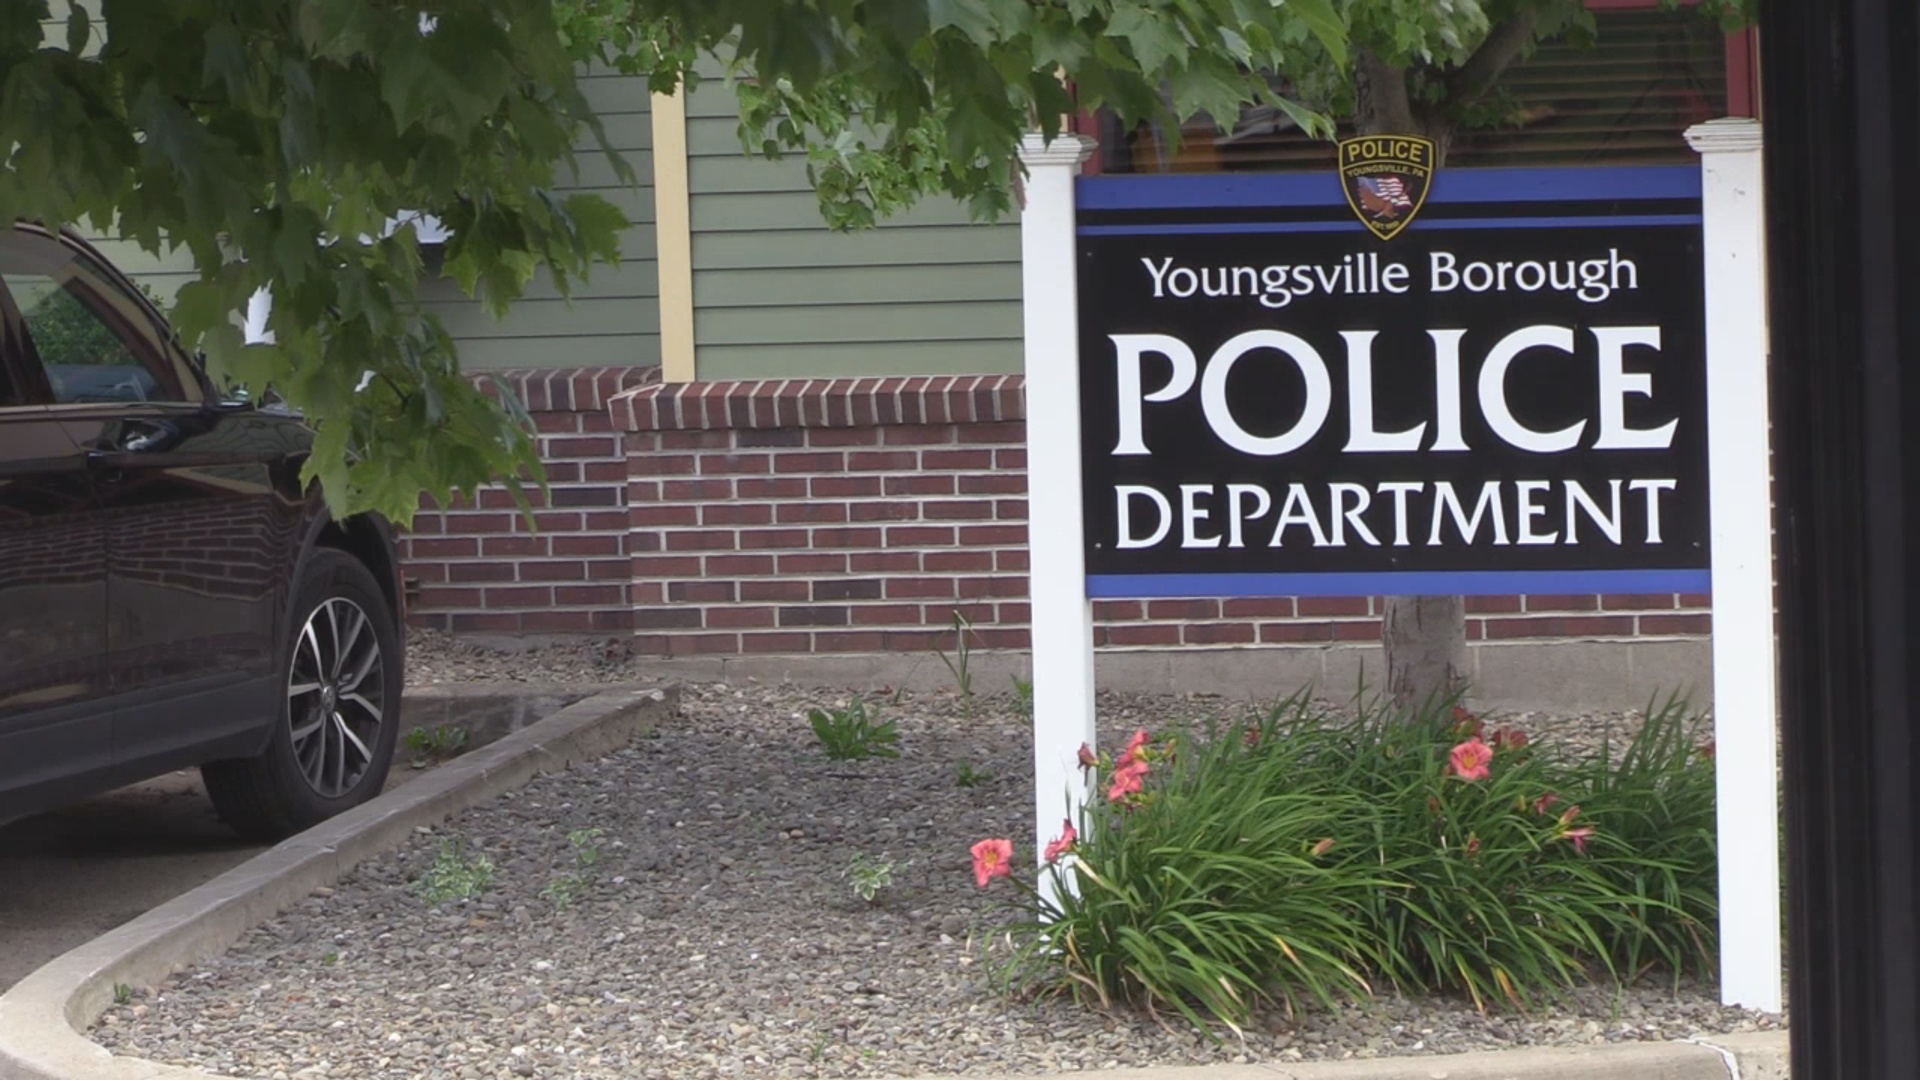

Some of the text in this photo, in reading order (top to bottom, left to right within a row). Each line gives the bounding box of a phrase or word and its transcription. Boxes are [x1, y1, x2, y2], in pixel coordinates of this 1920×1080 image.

[1348, 141, 1423, 161] POLICE
[1412, 169, 1424, 177] PA
[1140, 248, 1639, 308] Youngsville Borough
[1107, 324, 1680, 457] POLICE
[1114, 478, 1679, 549] DEPARTMENT
